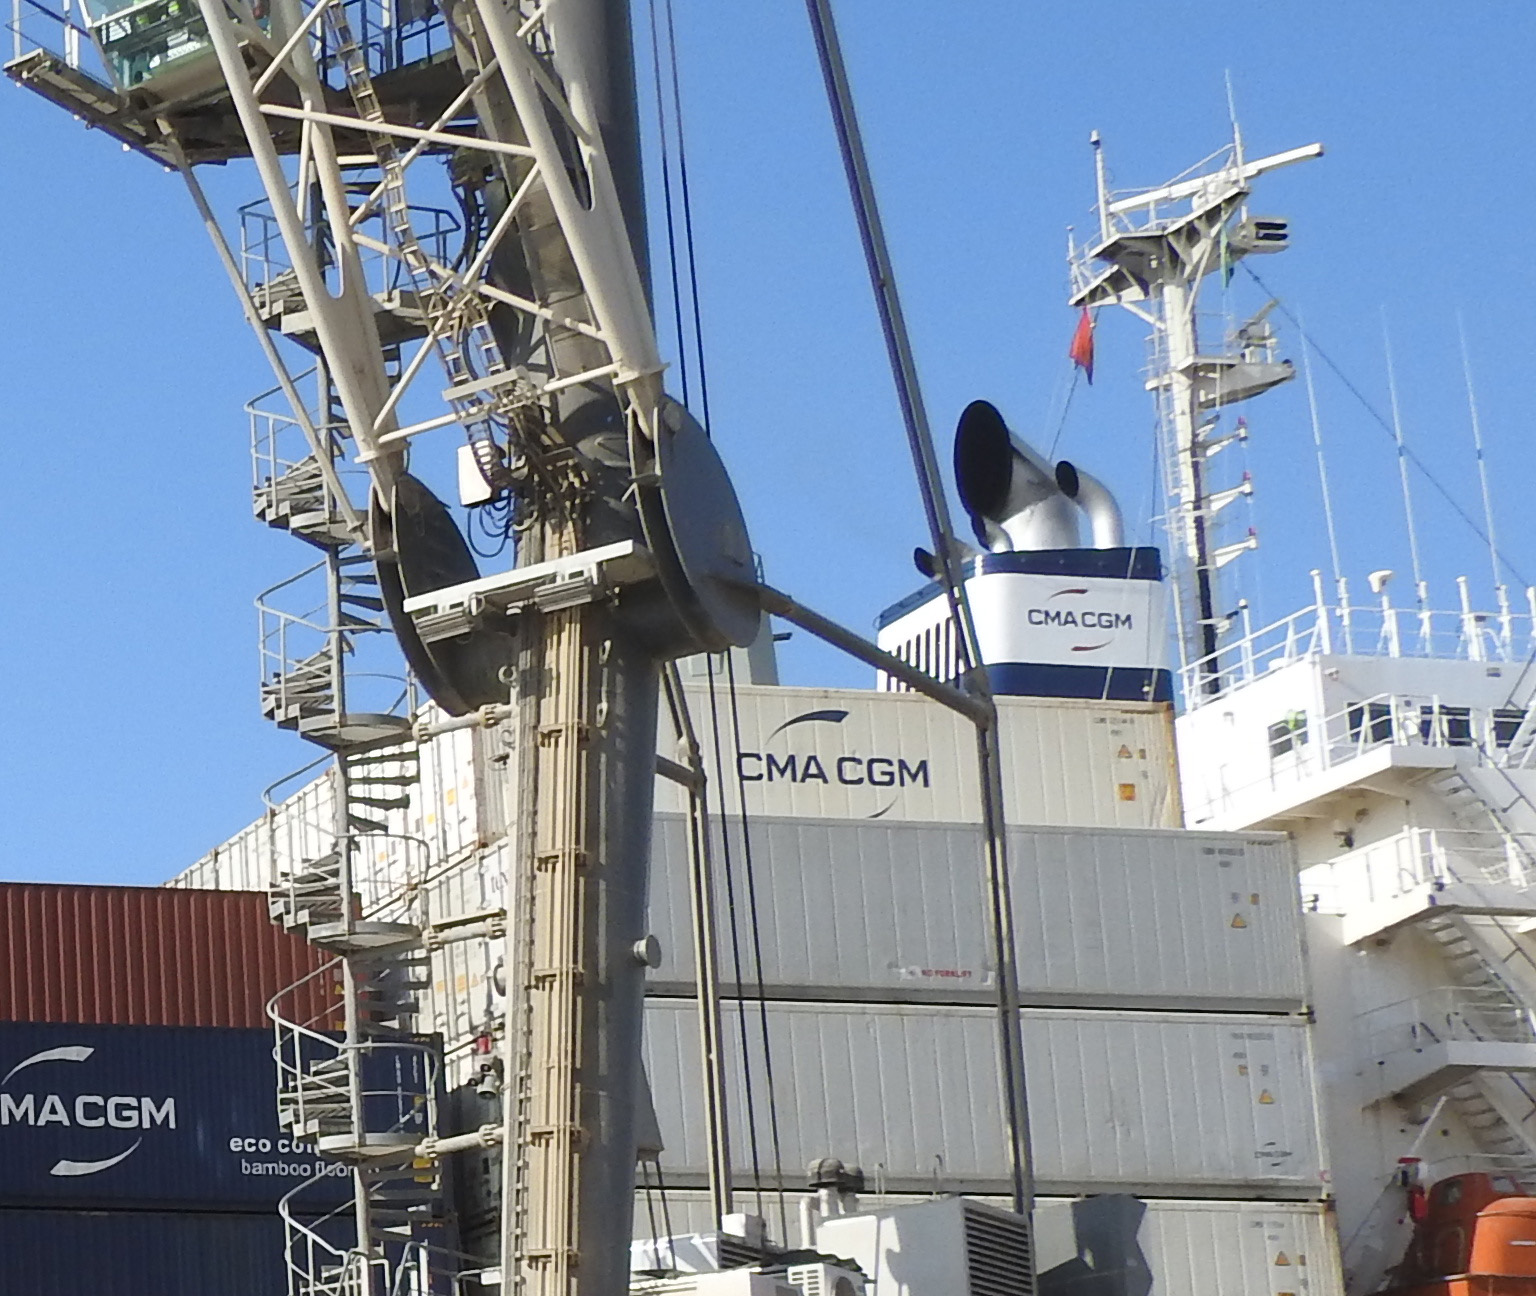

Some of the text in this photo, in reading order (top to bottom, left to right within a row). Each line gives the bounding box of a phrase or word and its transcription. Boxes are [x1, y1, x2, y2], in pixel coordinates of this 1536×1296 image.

[1028, 609, 1132, 630] CMA CGM
[738, 753, 929, 788] CMA CGM
[75, 1095, 176, 1130] CGM
[229, 1137, 272, 1153] eco
[241, 1159, 311, 1177] bamboo
